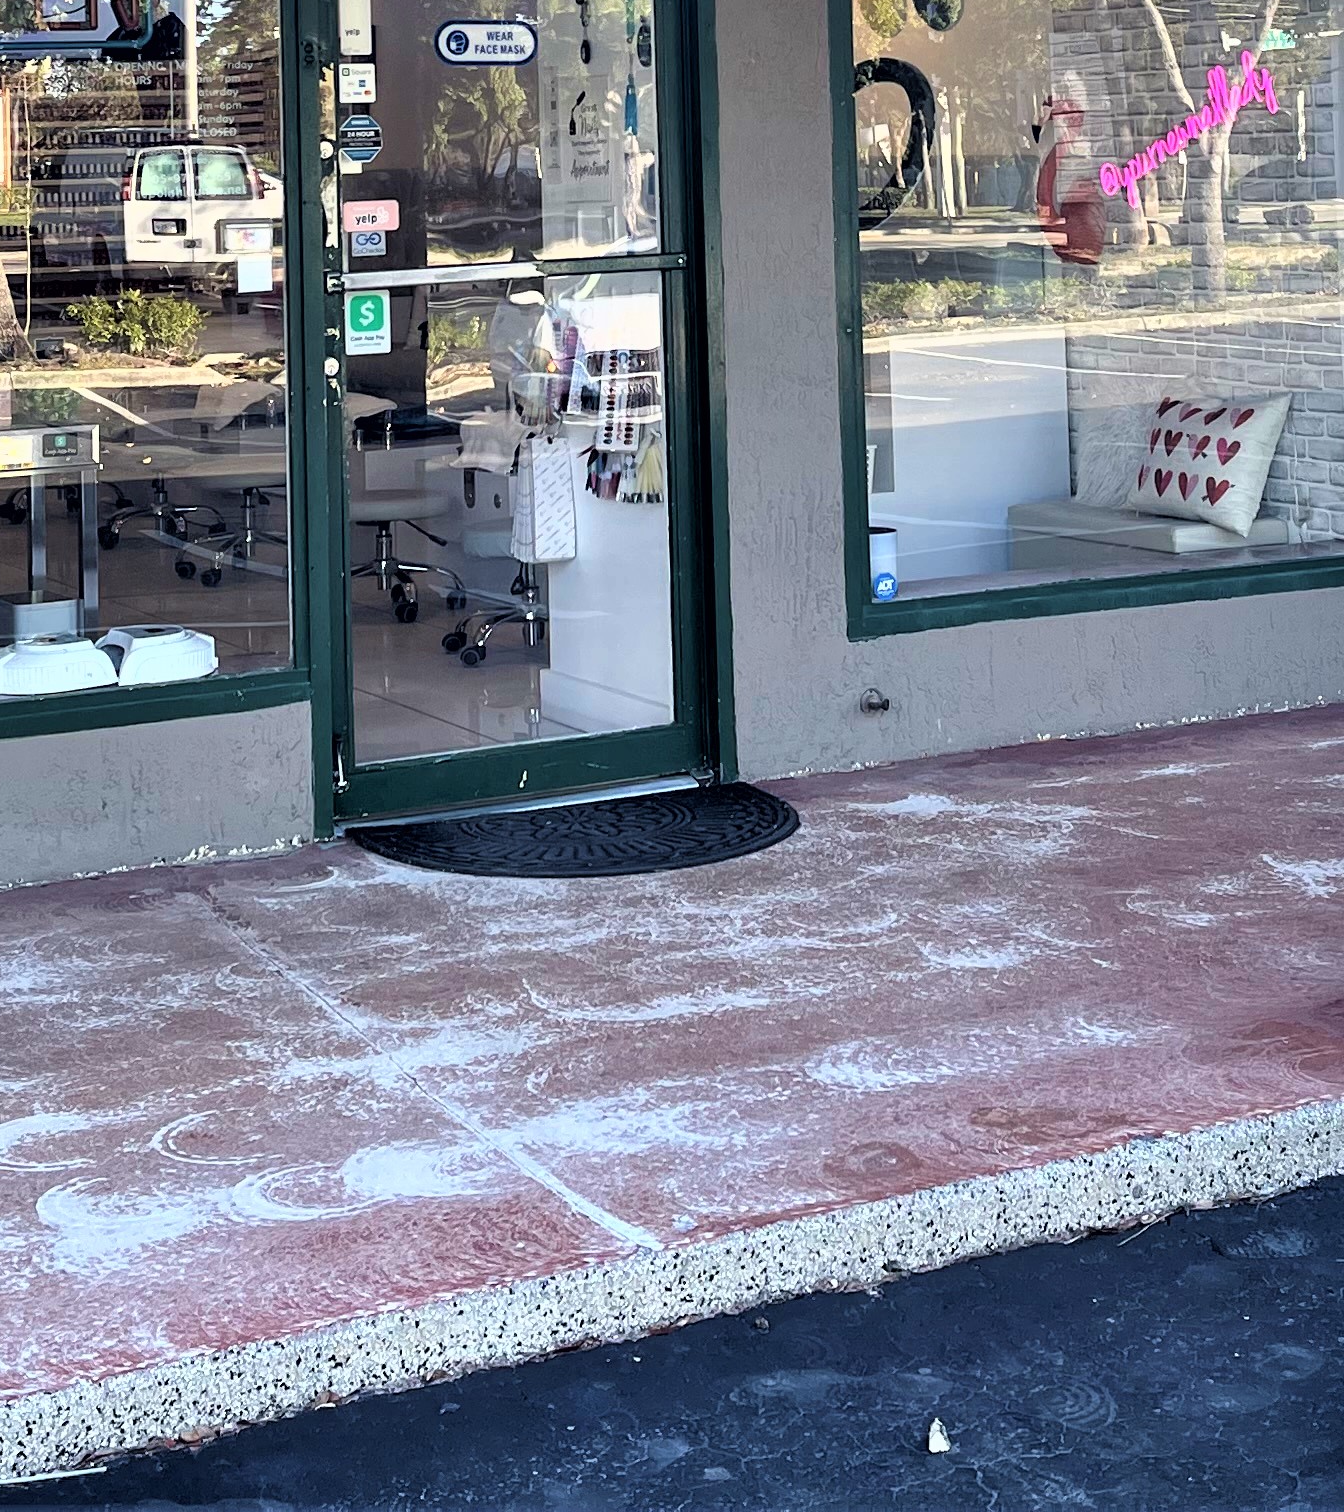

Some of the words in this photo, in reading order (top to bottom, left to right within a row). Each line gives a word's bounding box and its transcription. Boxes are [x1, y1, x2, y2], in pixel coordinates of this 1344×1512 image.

[345, 28, 360, 37] yelp
[487, 31, 513, 41] WEAR
[474, 44, 498, 55] FACE
[500, 44, 526, 55] MASK
[115, 75, 152, 86] HOURS
[355, 214, 378, 225] yelp
